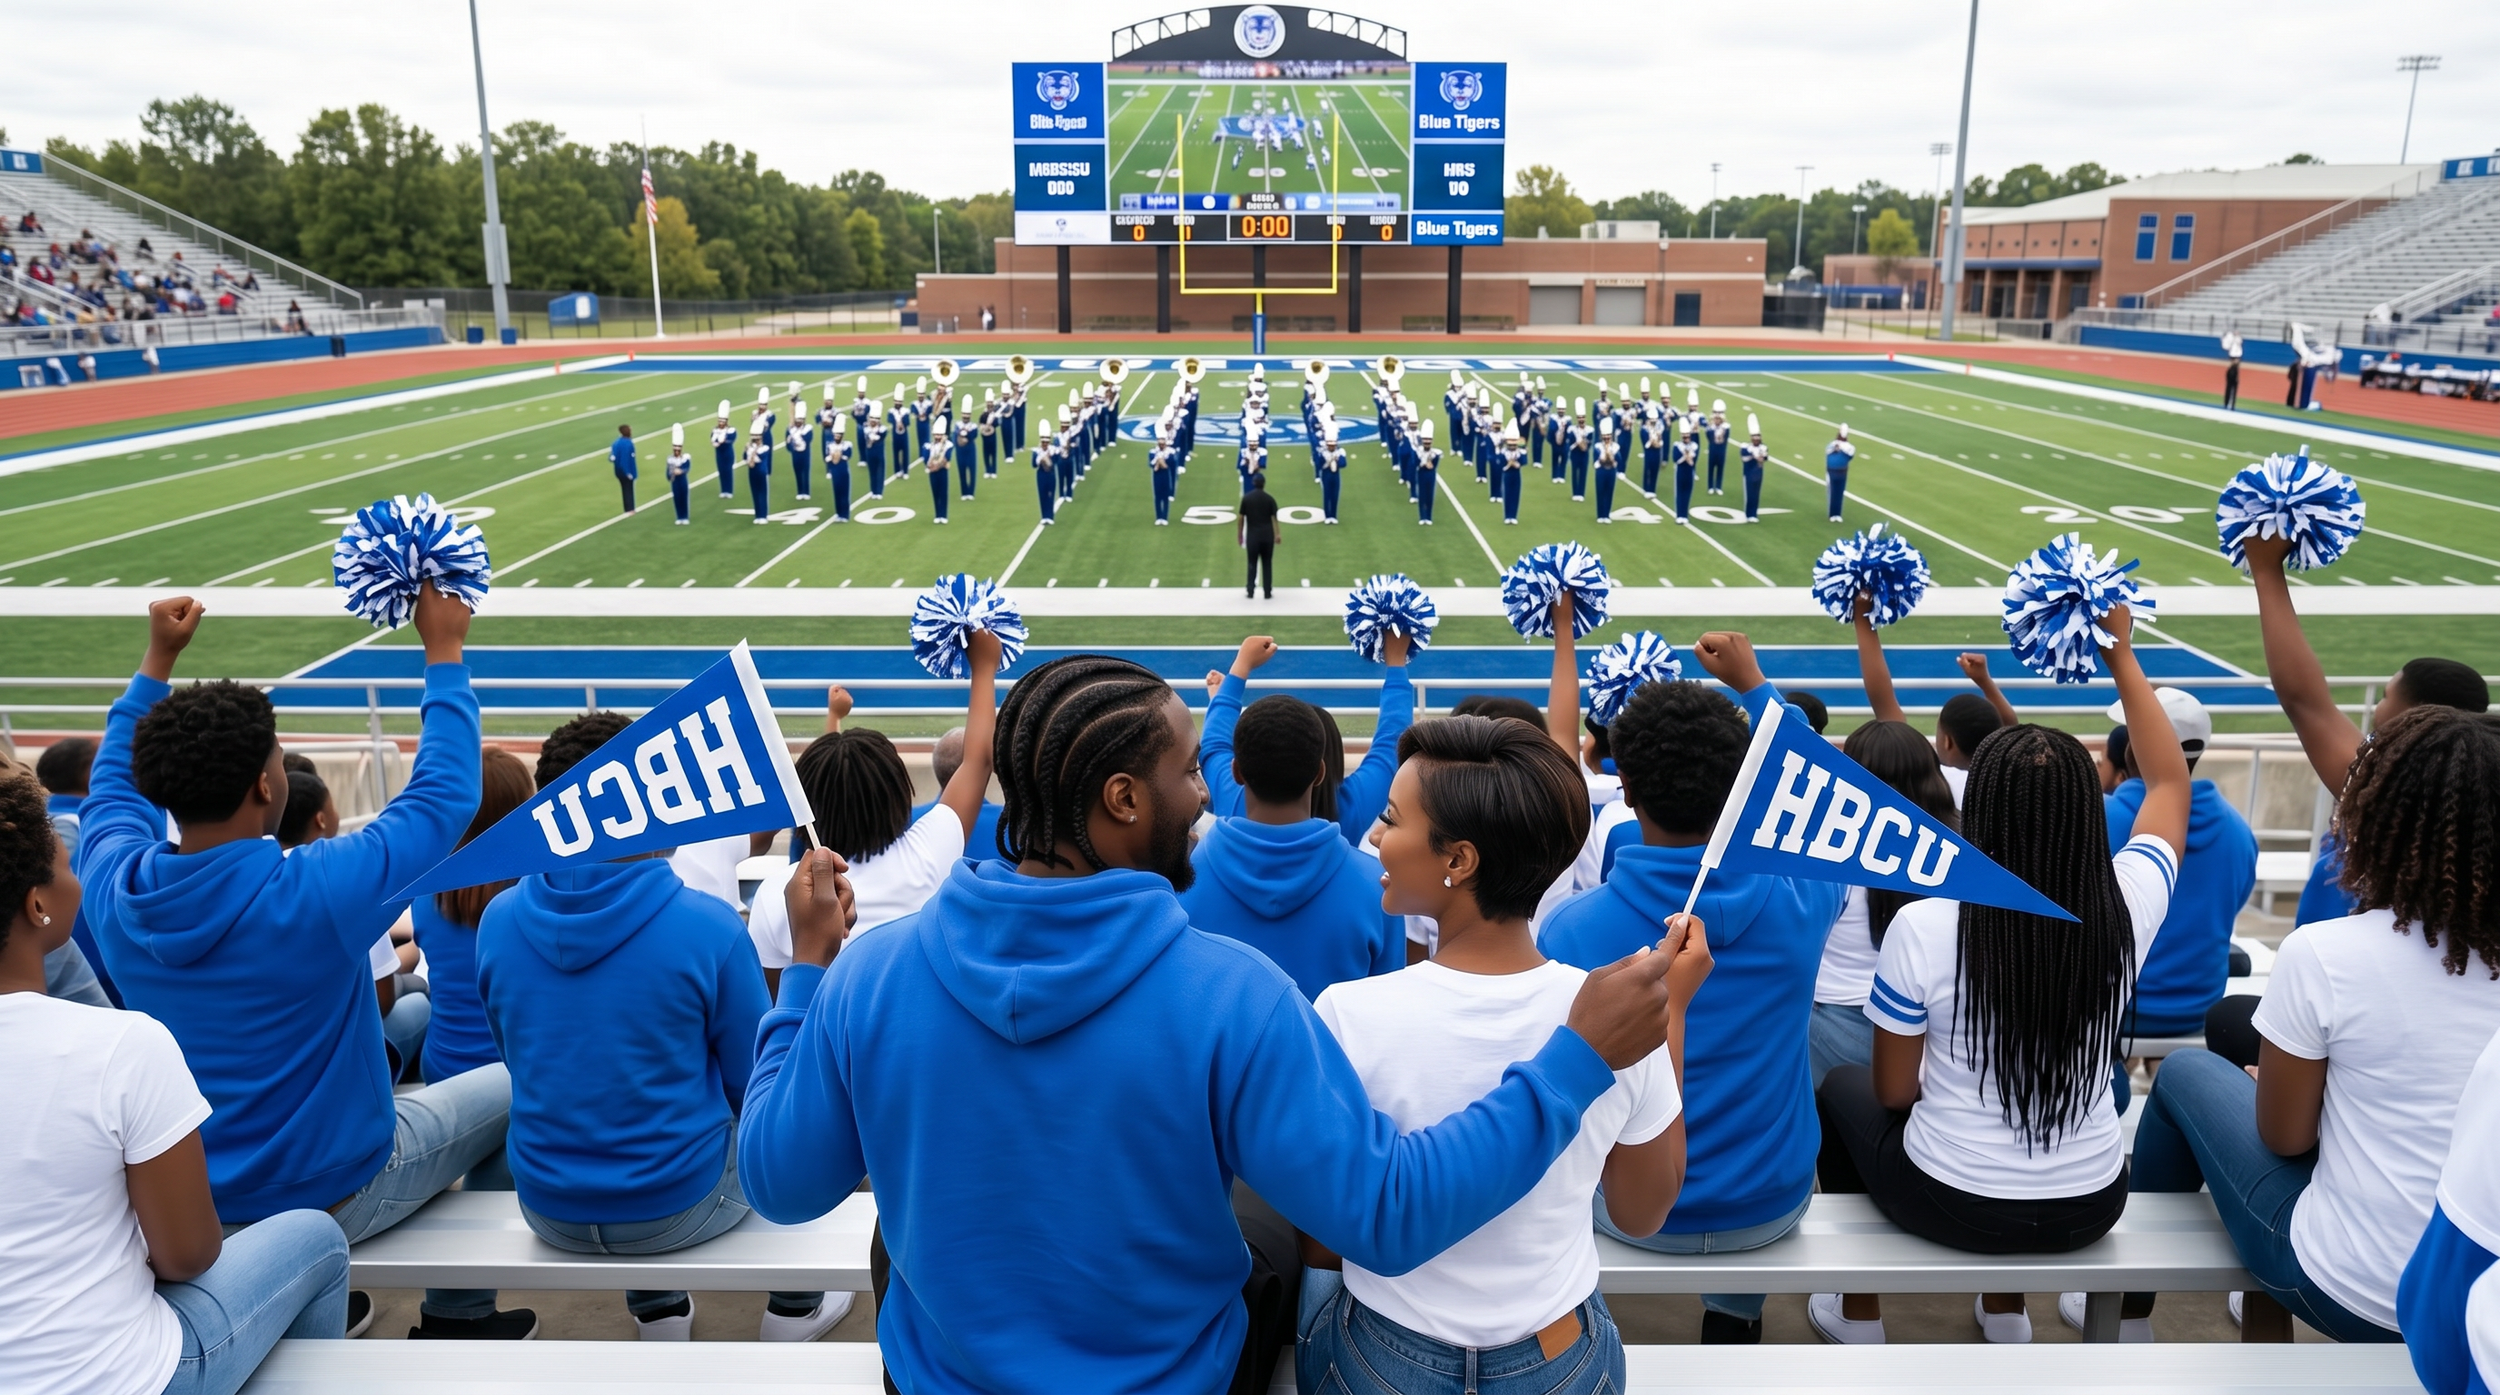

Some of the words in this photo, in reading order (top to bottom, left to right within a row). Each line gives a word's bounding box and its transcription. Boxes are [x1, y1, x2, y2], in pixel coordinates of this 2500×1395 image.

[1419, 114, 1451, 129] Blue
[1454, 114, 1501, 133] Tigers
[1242, 215, 1289, 238] 0:00
[1416, 221, 1450, 236] Blue
[1453, 221, 1499, 239] Tigers
[1751, 749, 1960, 887] HBCU
